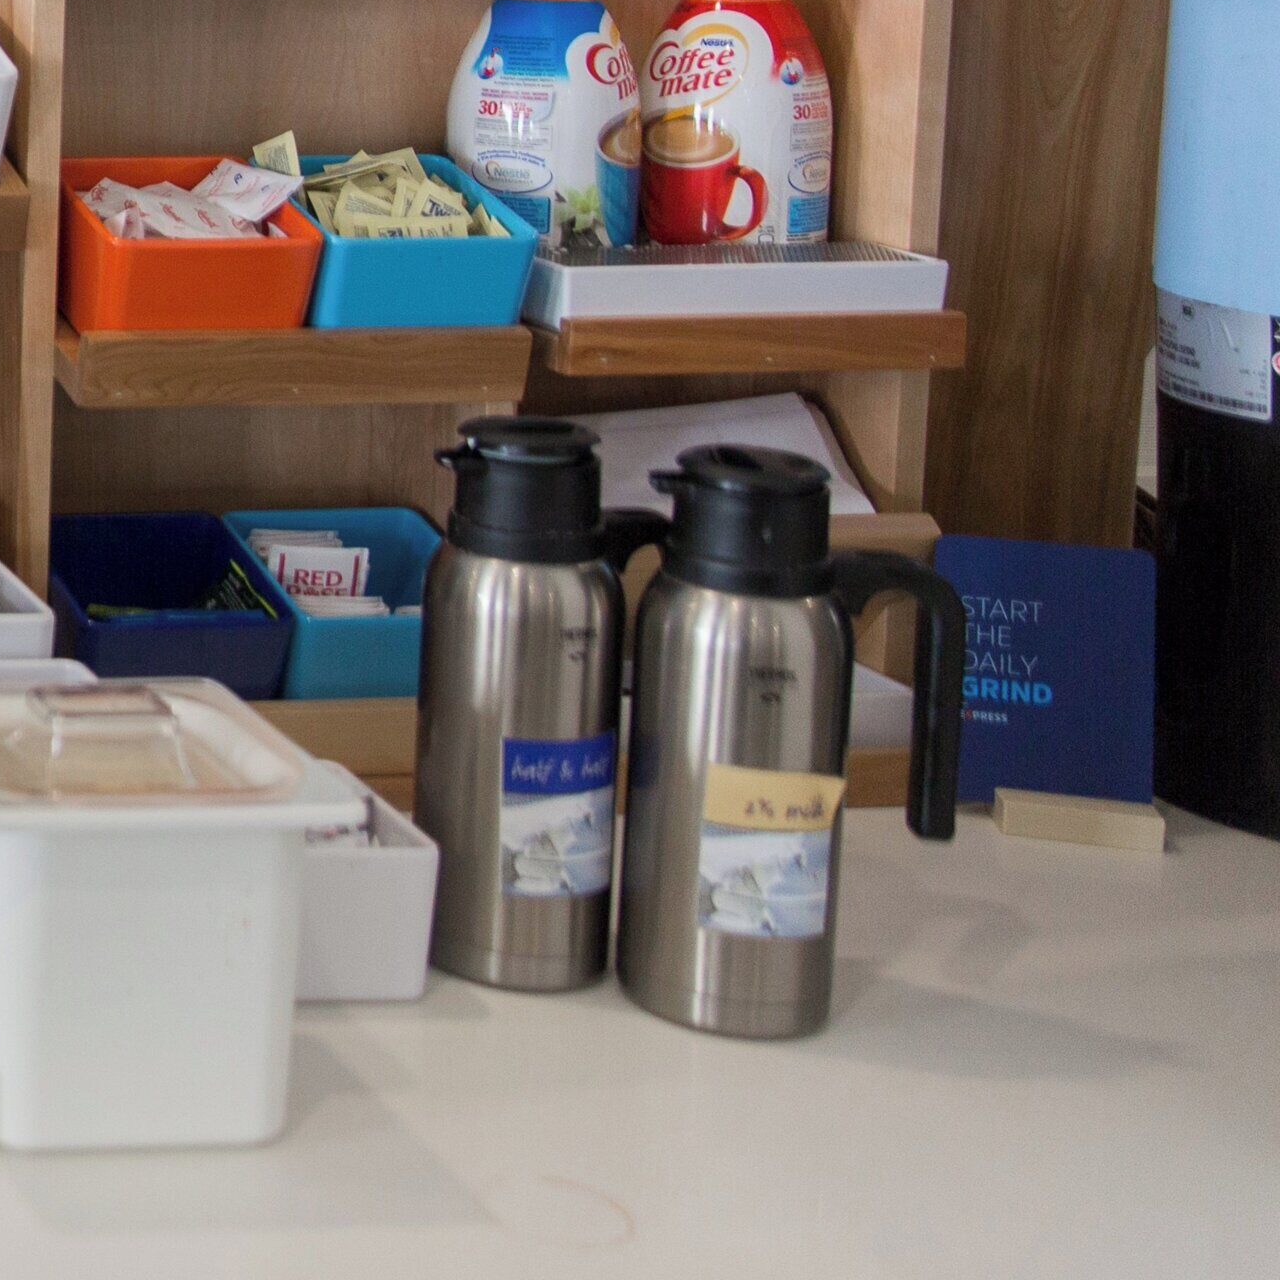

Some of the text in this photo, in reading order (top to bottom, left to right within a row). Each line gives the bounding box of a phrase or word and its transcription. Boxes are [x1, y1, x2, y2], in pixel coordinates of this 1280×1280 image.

[584, 42, 637, 85] Coff
[649, 40, 735, 82] Coffee
[659, 68, 732, 97] mate
[478, 100, 498, 116] 30
[793, 103, 811, 120] 30
[294, 567, 343, 587] RED
[961, 595, 1043, 623] START
[964, 623, 1012, 647] THE
[963, 649, 1039, 677] DAILY
[962, 675, 1053, 705] GRIND
